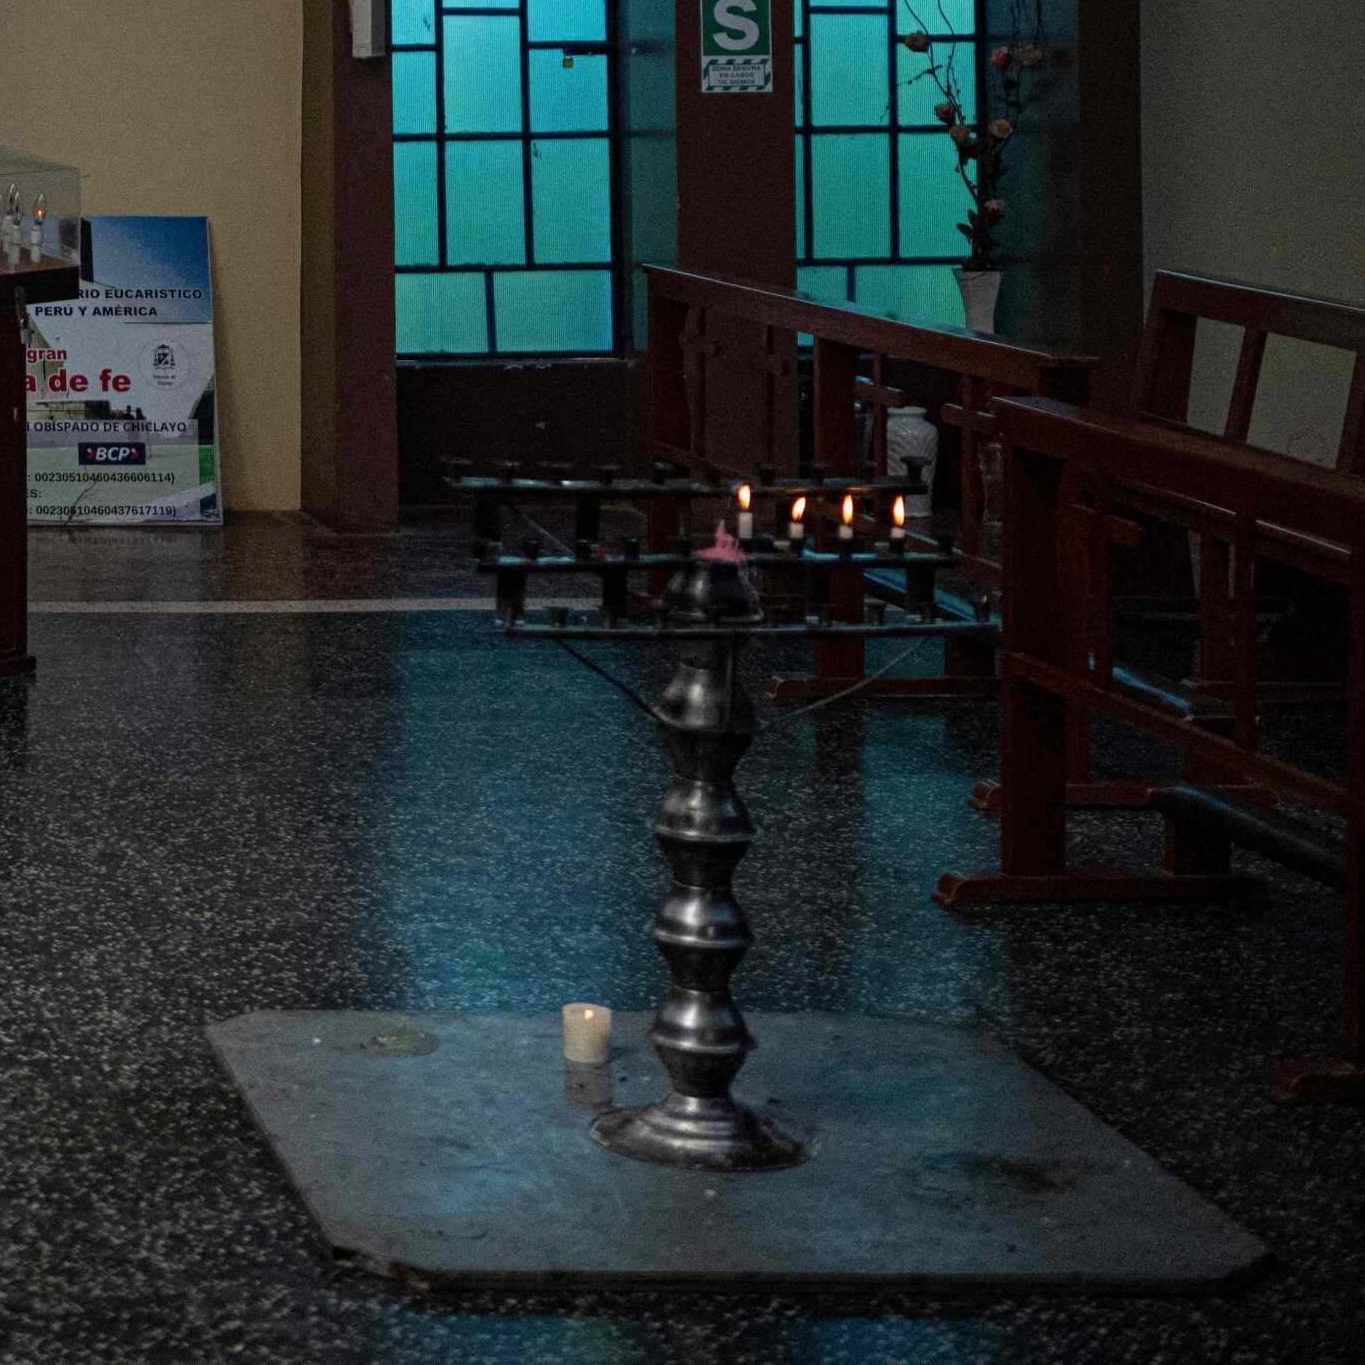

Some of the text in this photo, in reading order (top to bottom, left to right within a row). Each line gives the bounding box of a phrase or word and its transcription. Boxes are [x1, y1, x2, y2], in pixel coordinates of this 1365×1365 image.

[105, 288, 202, 299] EUCARÍSTICO
[35, 304, 158, 316] PERÚ Y AMÉRICA
[27, 349, 68, 364] gran
[49, 369, 89, 392] de
[99, 369, 132, 392] fe
[33, 421, 100, 433] OBISPADO
[103, 421, 120, 433] DE
[122, 421, 187, 433] CHICLAYO
[95, 446, 132, 462] BCP
